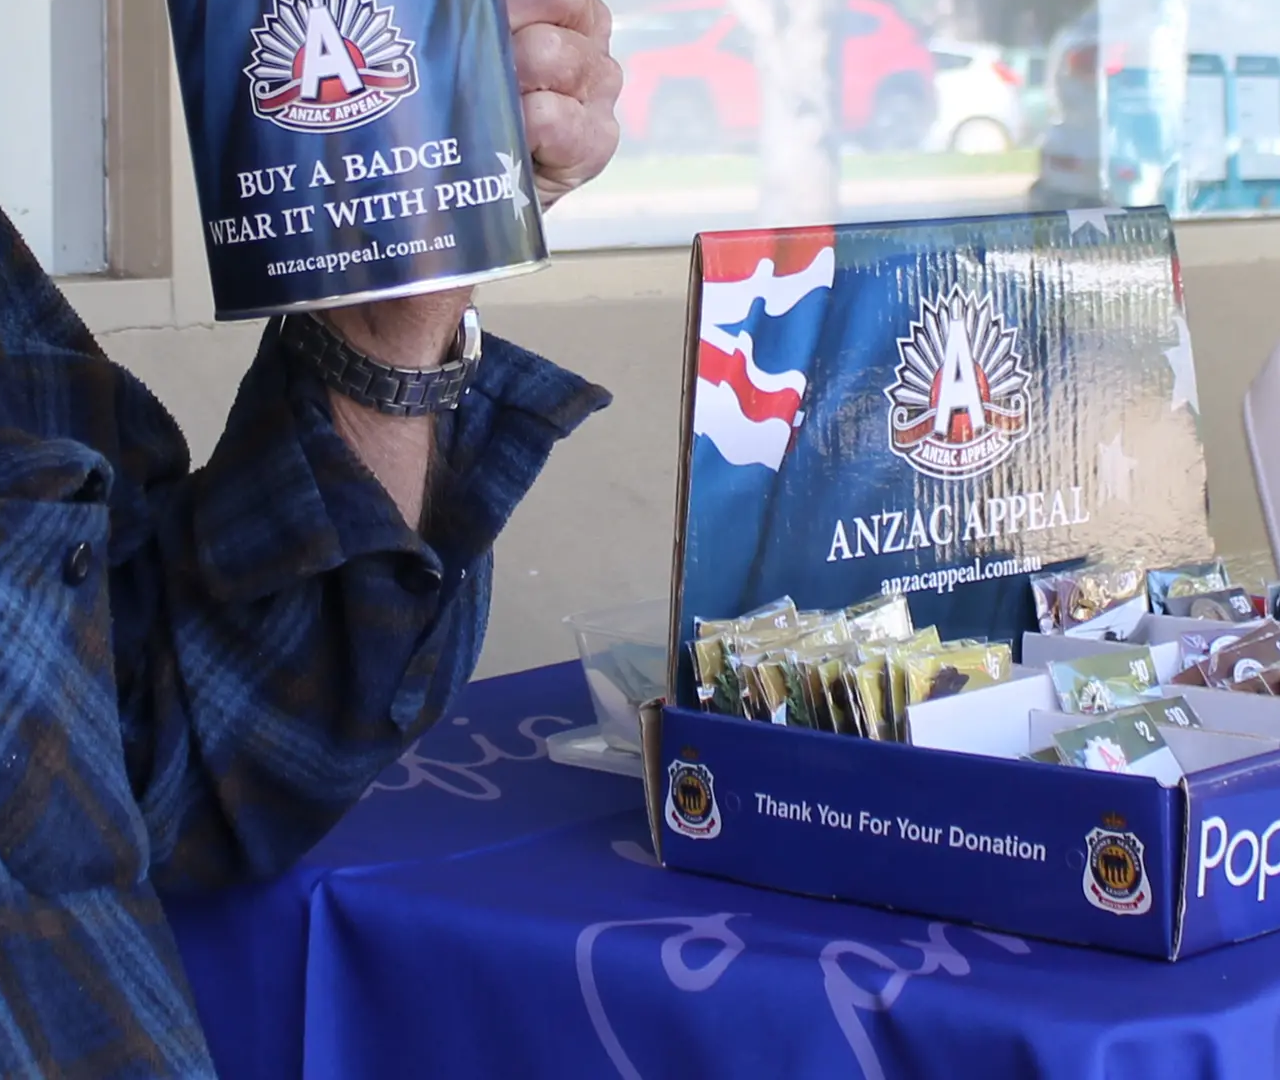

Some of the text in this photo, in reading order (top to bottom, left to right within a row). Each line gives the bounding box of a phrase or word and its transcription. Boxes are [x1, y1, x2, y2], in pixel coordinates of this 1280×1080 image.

[300, 5, 367, 102] A
[288, 93, 384, 122] ANZAC APPEAL
[236, 137, 462, 200] BUY A BADGE
[209, 171, 516, 248] WEAR IT WITH PRIDE
[266, 232, 457, 277] anzacappeal.com.au
[921, 435, 1001, 467] ANZAC APPEAL
[825, 485, 1091, 563] ANZAC APPEAL
[879, 555, 1043, 596] anzacappeal.com.au
[1129, 659, 1150, 683] $10
[1134, 720, 1156, 743] $2
[1163, 706, 1189, 727] $10
[754, 791, 1047, 863] Thank You For Your Donation
